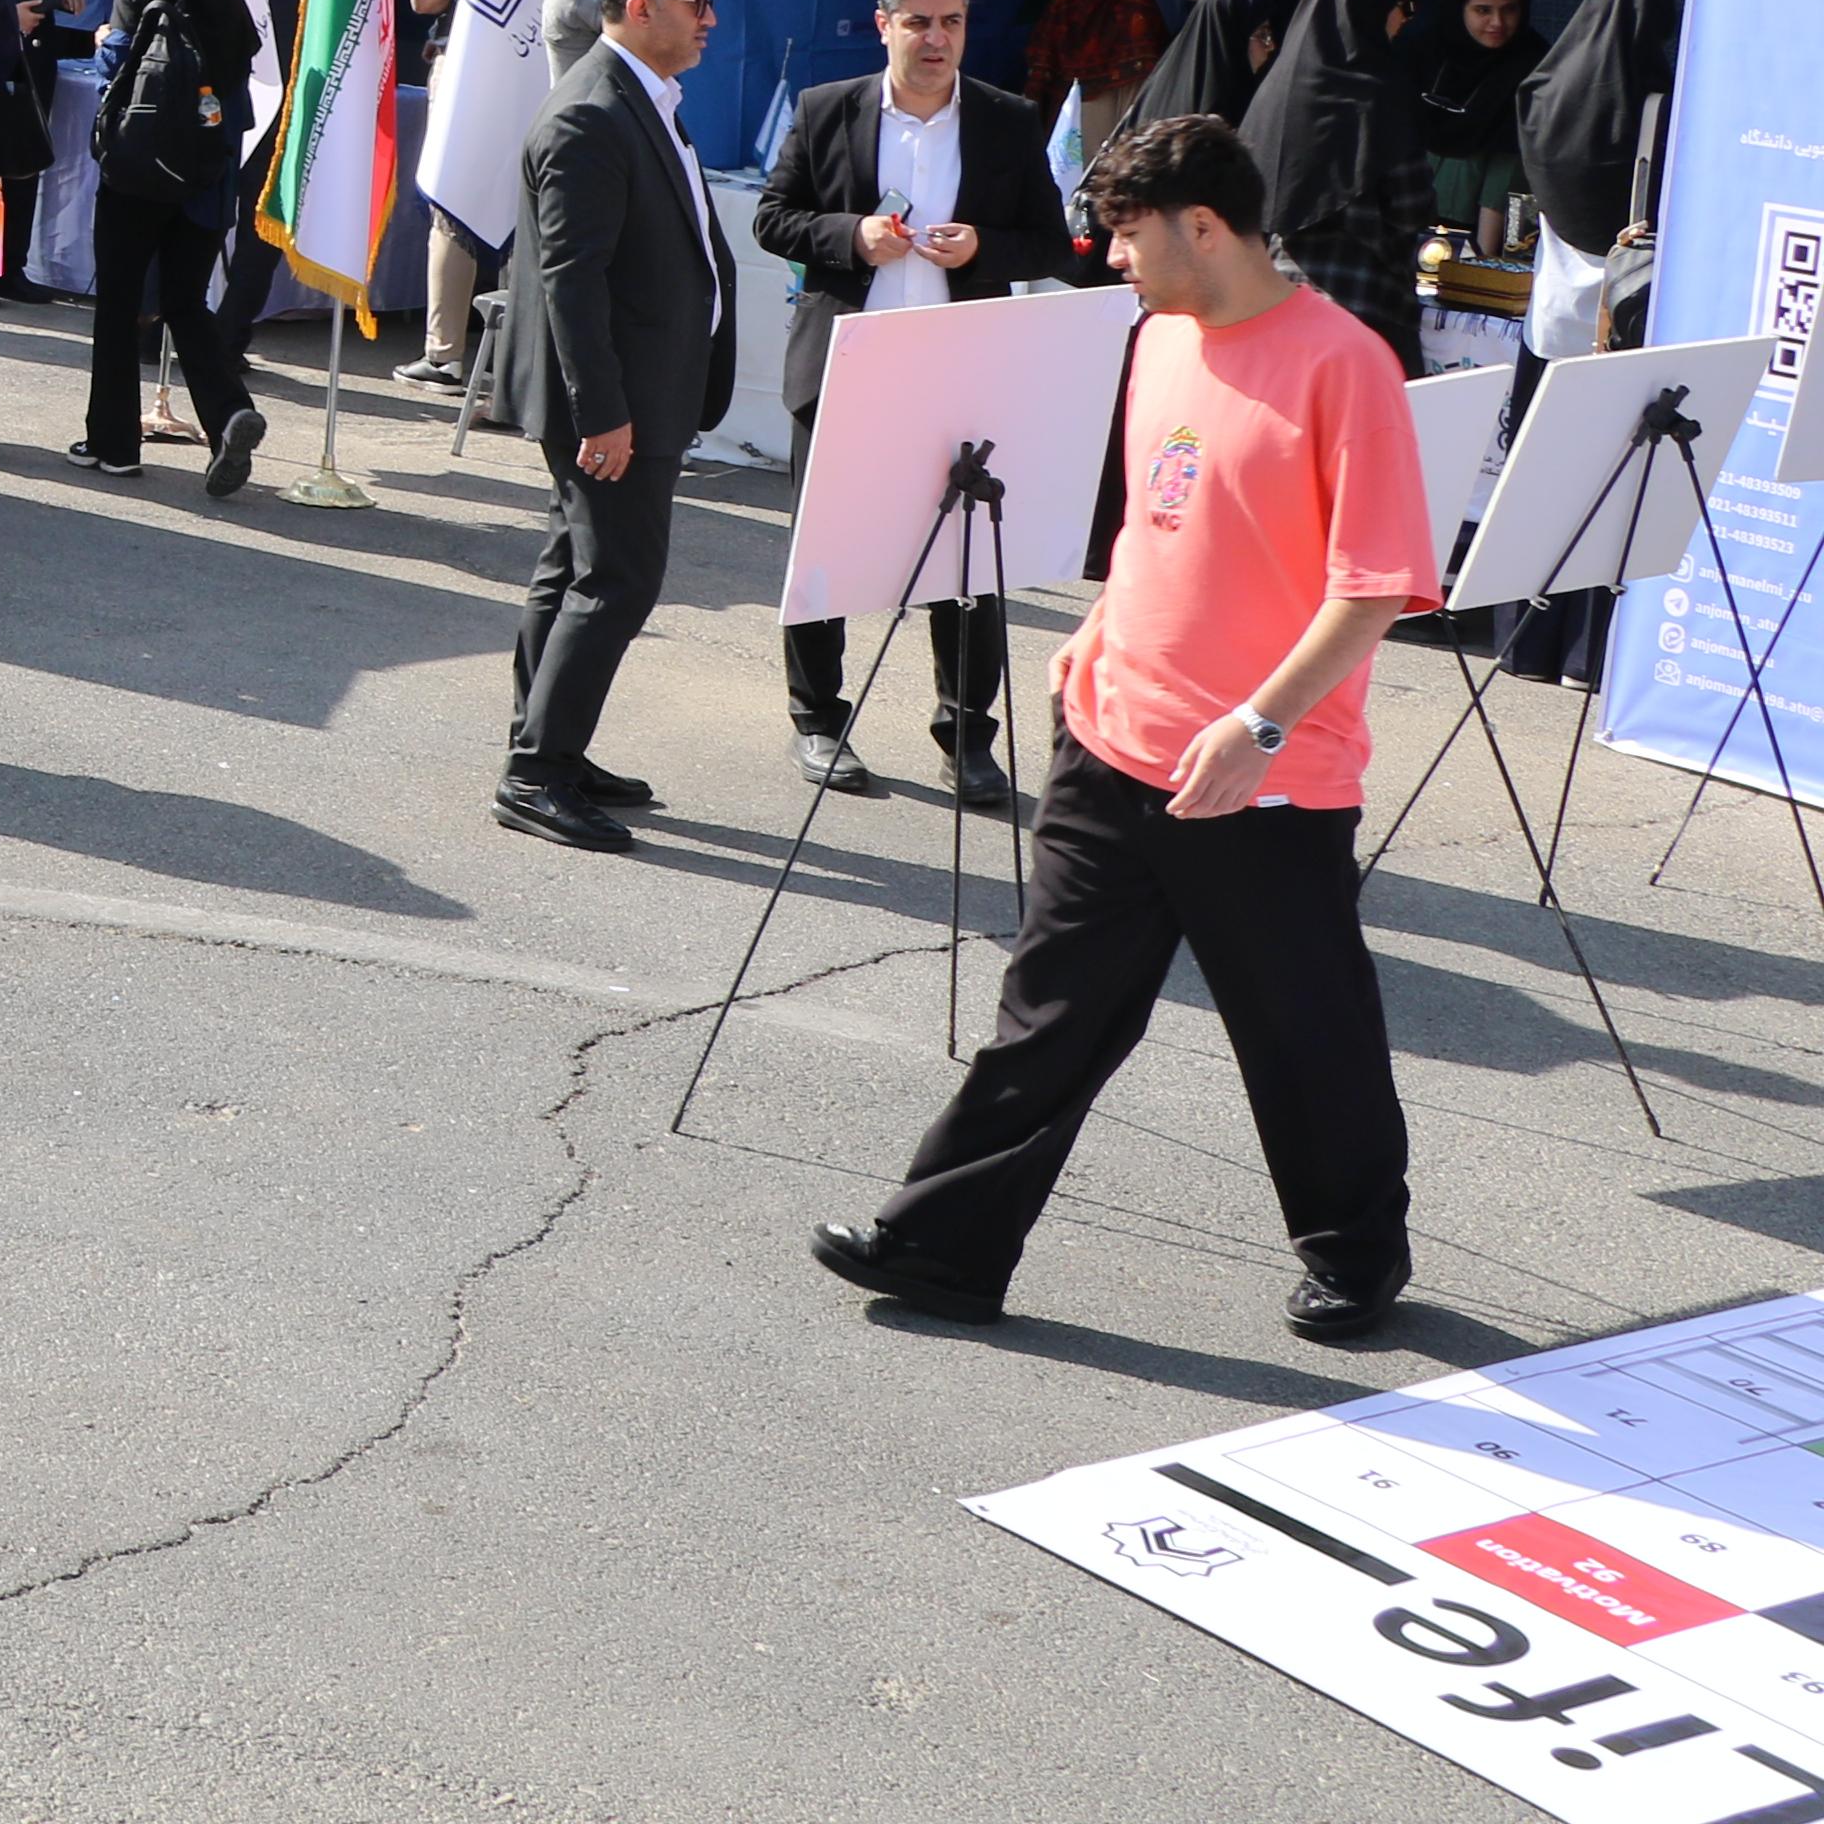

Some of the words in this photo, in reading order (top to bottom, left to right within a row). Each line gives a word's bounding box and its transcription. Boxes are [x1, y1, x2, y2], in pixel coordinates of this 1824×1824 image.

[1740, 127, 1793, 151] دانشگاه
[1717, 469, 1802, 500] 21-48393509
[1706, 495, 1799, 529] 021-48393511
[1705, 523, 1795, 555] 21-48393523
[1727, 1376, 1773, 1397] 70
[1604, 1406, 1650, 1428] 71
[1473, 1438, 1521, 1462] 90
[1356, 1468, 1402, 1490] 91
[1678, 1531, 1729, 1554] 89
[1474, 1537, 1659, 1627] Motivation
[1572, 1556, 1628, 1585] 92
